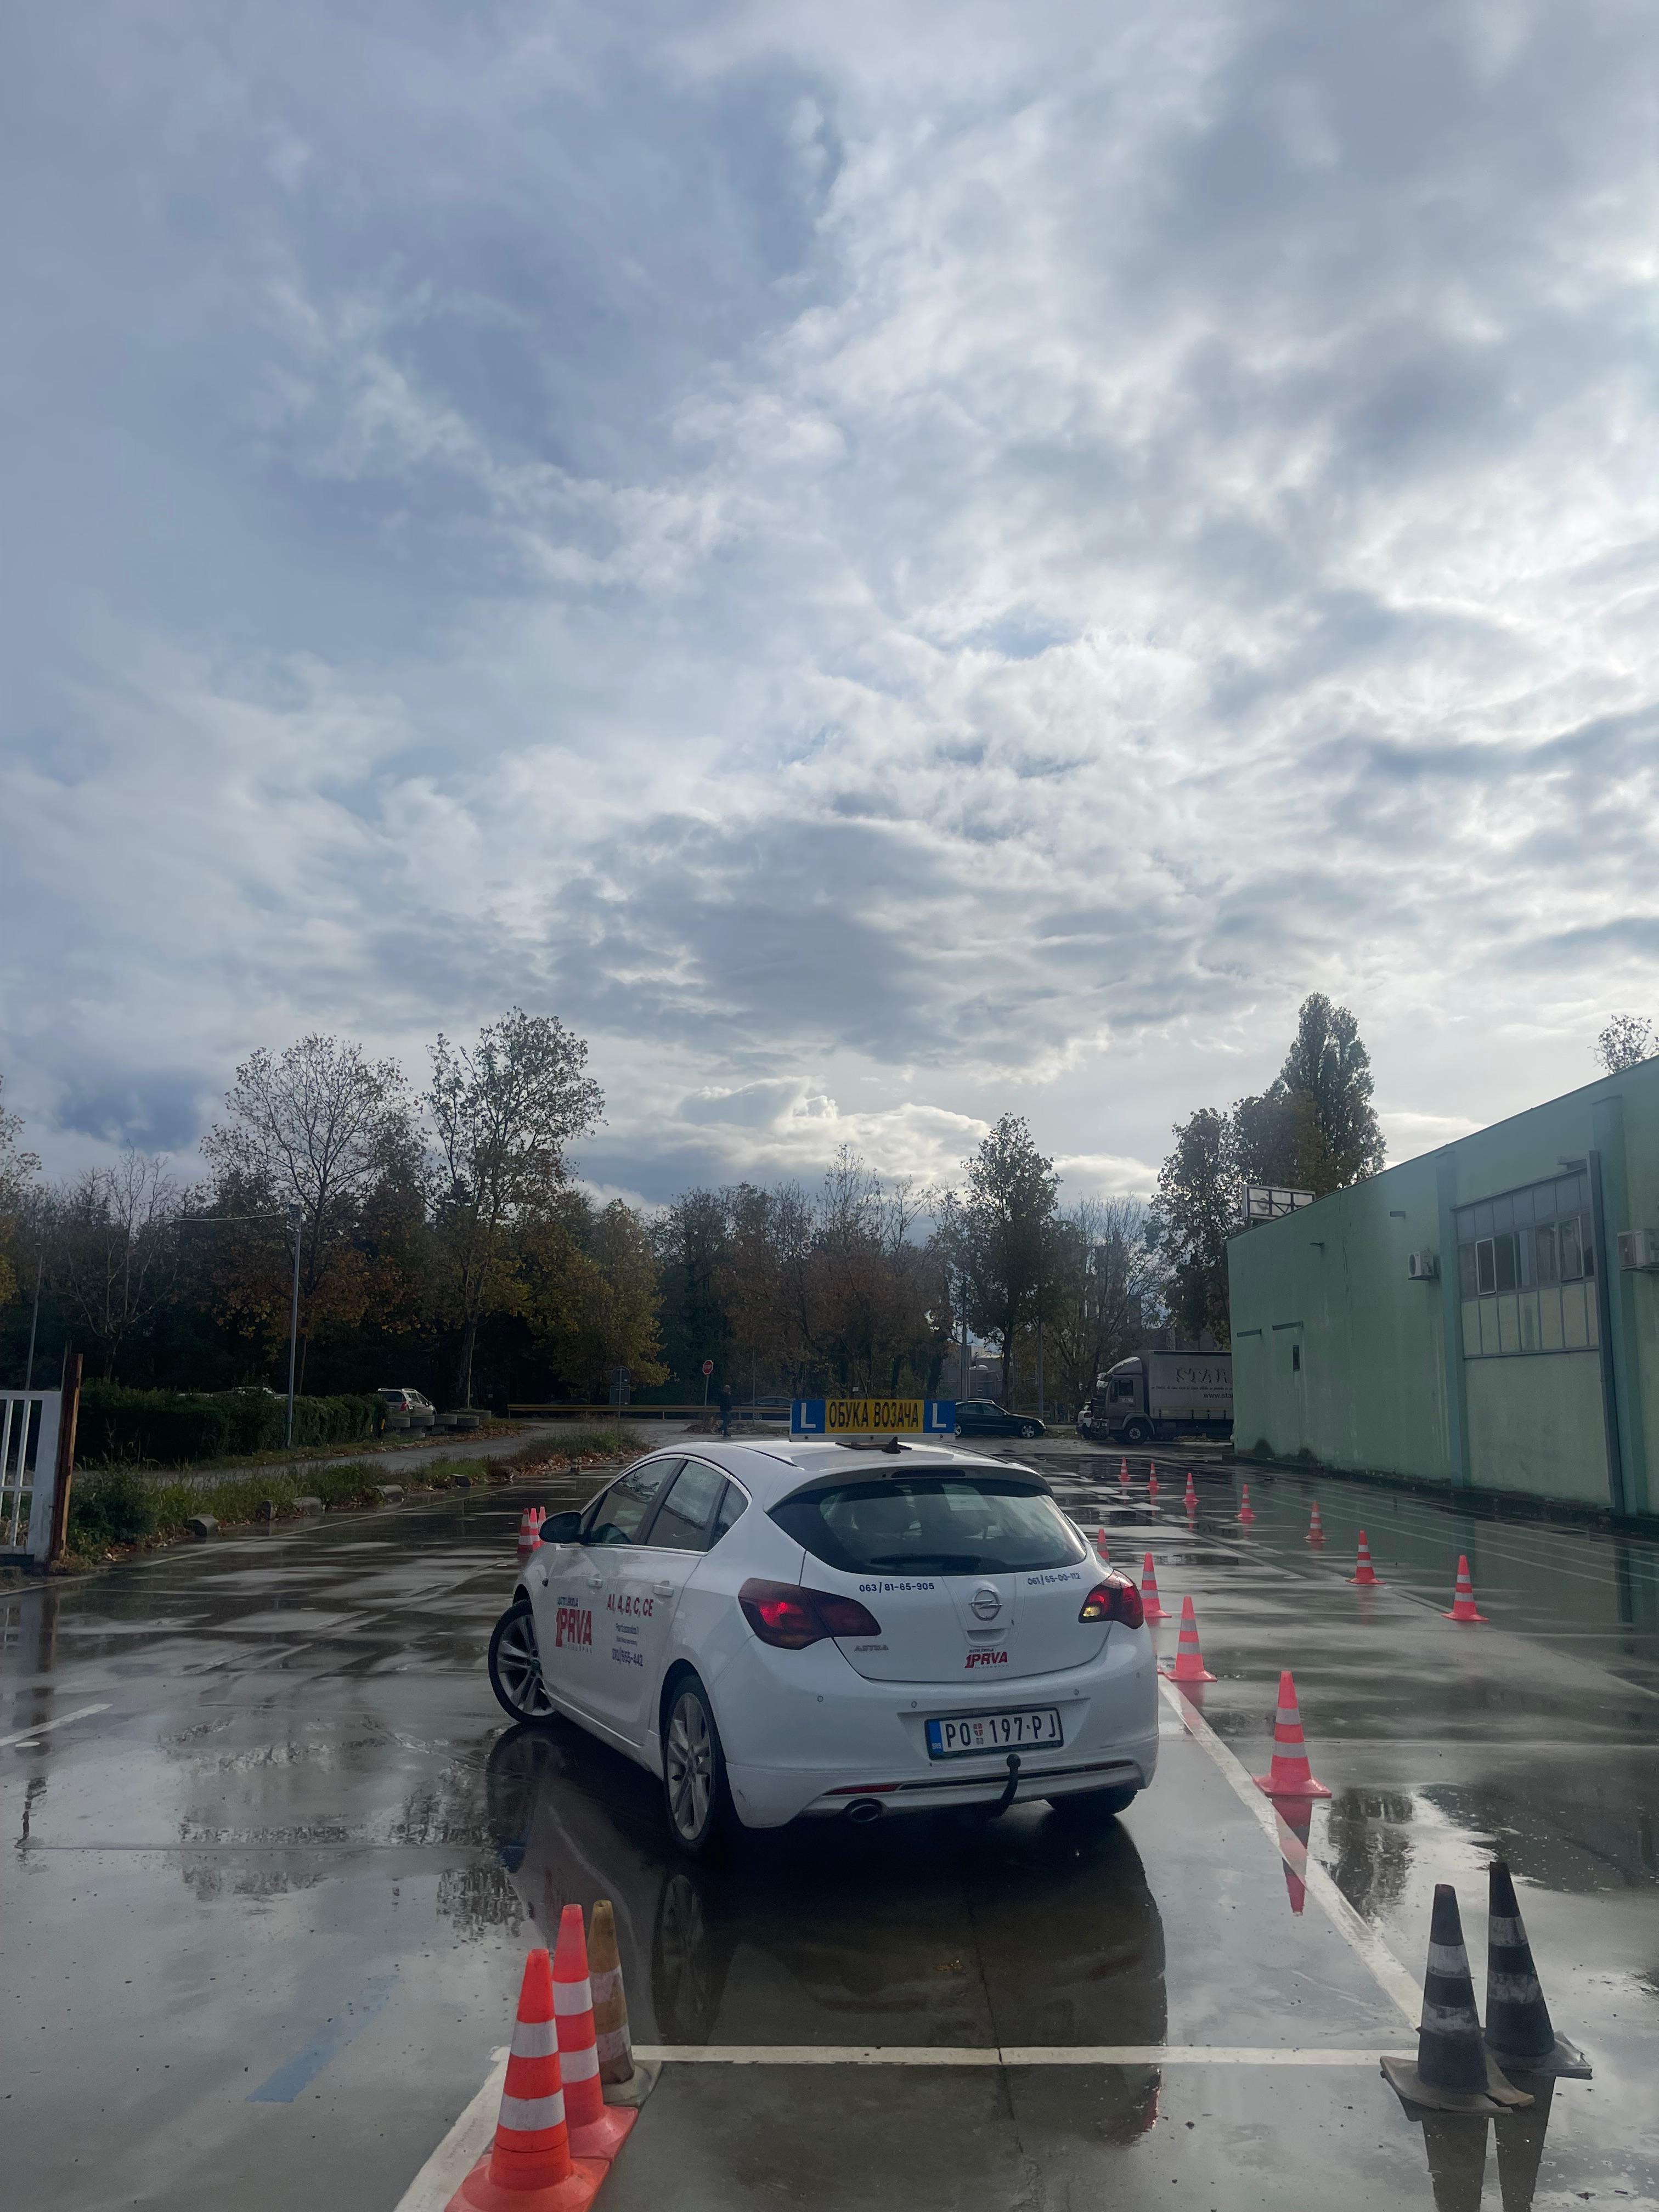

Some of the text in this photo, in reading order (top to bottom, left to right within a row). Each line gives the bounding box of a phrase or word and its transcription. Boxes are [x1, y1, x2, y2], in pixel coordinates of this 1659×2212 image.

[801, 1402, 816, 1428] L
[829, 1402, 919, 1427] ОБУКА ВОЗАЧА
[932, 1403, 946, 1428] L
[859, 1582, 934, 1593] 063/81-65-905
[642, 1599, 654, 1616] CE
[945, 1722, 971, 1747] PO
